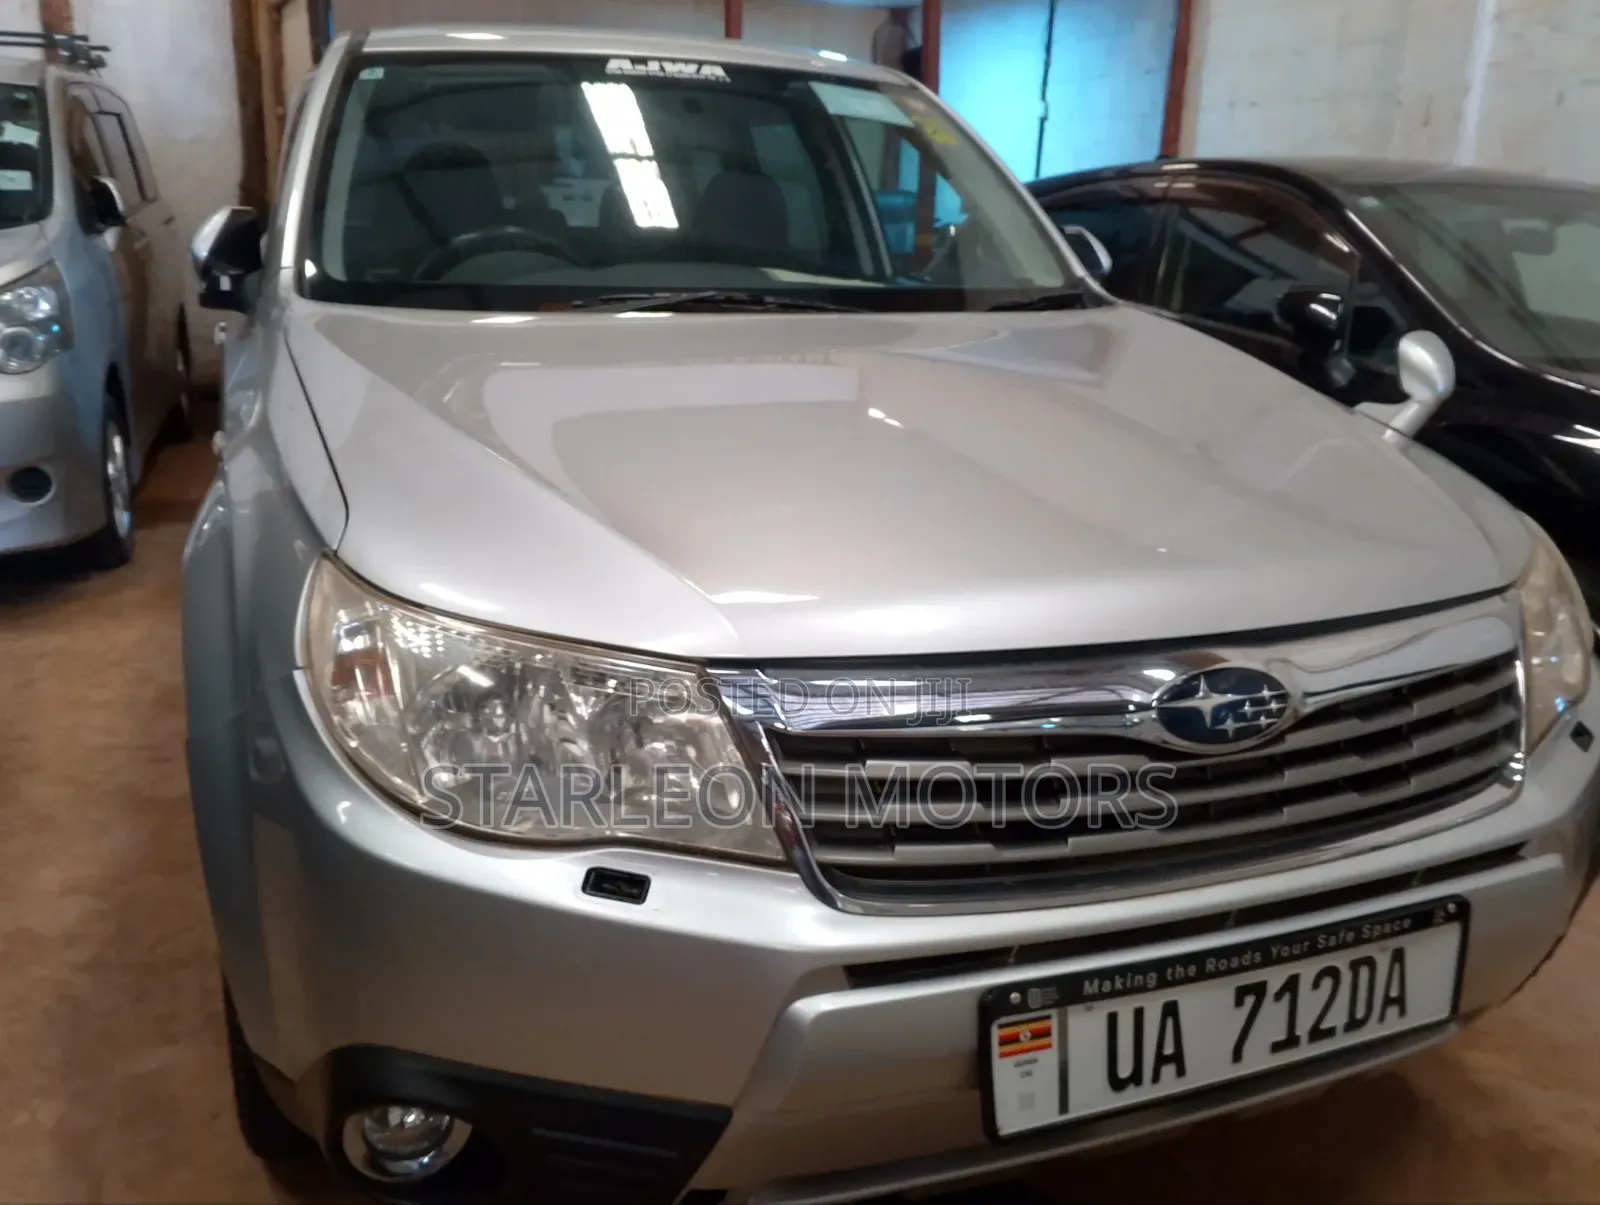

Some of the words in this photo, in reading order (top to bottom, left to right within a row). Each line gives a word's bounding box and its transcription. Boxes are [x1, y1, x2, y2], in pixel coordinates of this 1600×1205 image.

[1083, 972, 1157, 996] Making
[1166, 963, 1197, 980] the
[1205, 950, 1262, 974] Roads
[1270, 941, 1309, 959] Your
[1317, 928, 1355, 950] Safe
[1361, 916, 1412, 940] Space
[1107, 999, 1186, 1093] UA
[1230, 946, 1407, 1064] 712DA
